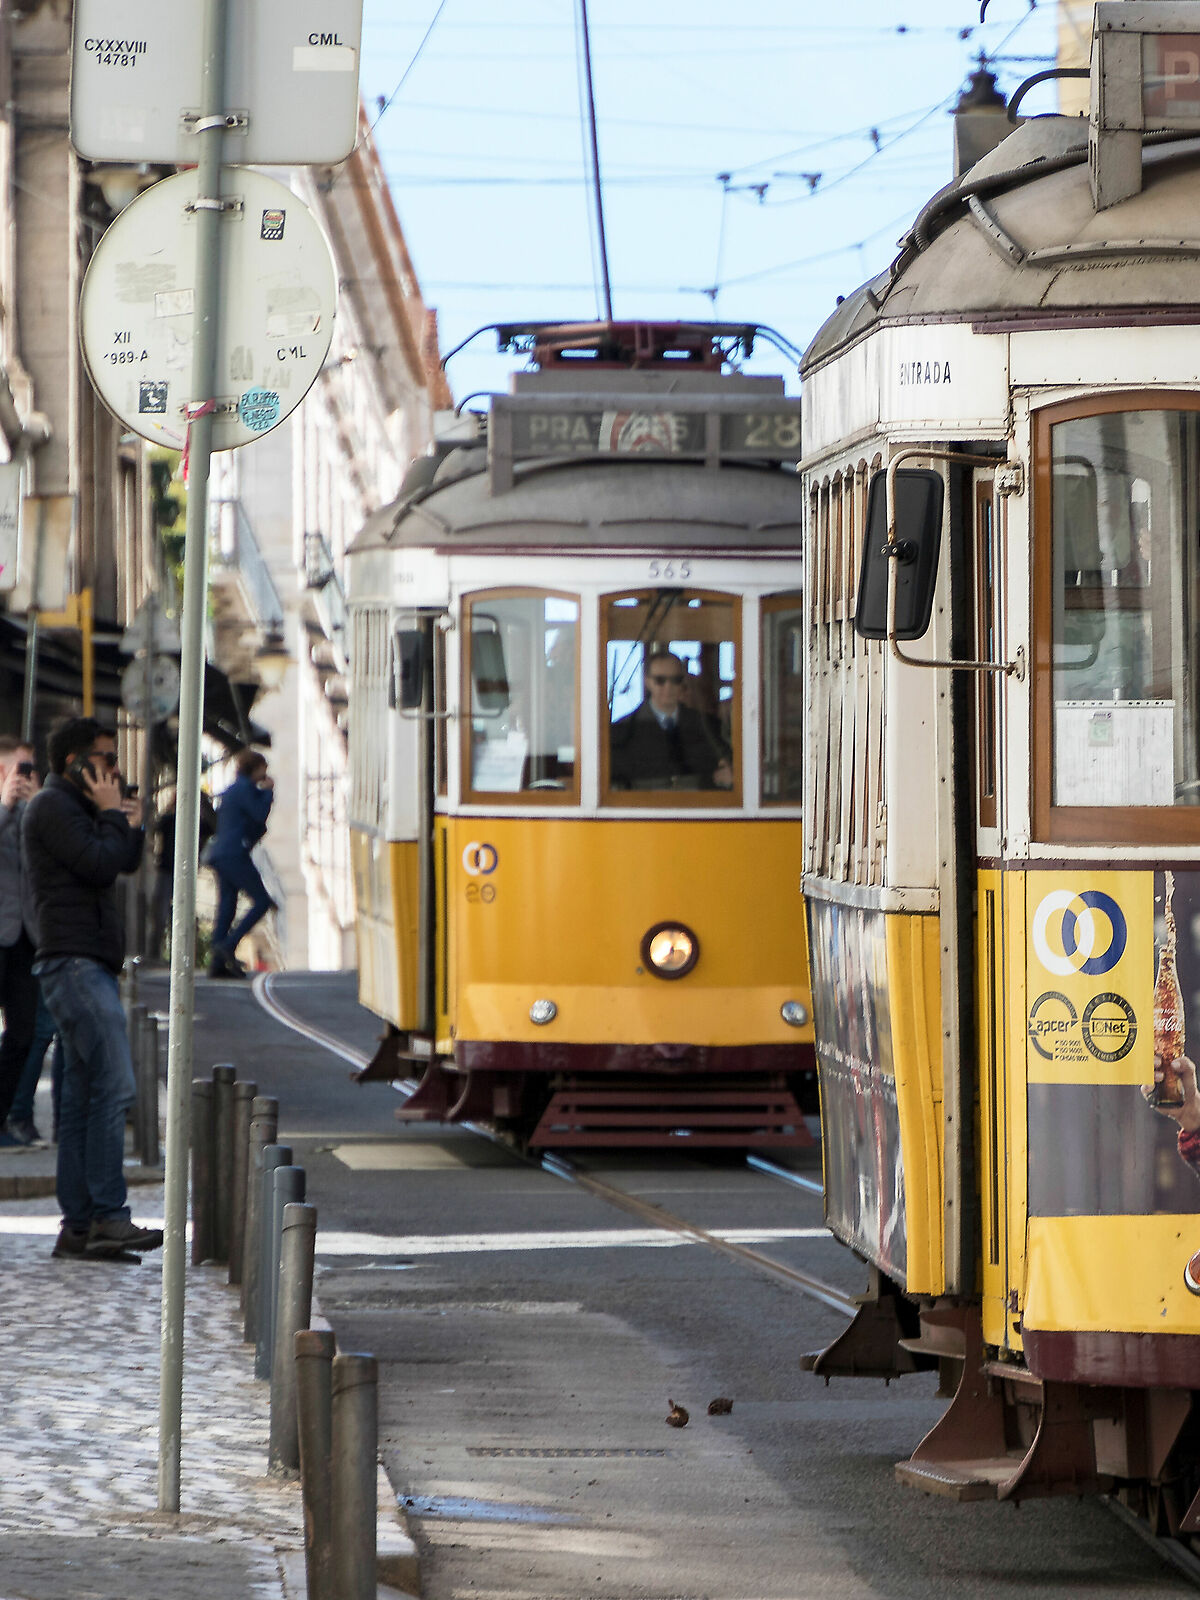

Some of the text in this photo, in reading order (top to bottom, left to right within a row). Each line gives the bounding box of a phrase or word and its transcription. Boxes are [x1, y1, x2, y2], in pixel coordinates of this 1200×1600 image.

[84, 38, 147, 53] CXXXVIII
[308, 33, 343, 46] CML
[96, 52, 136, 67] 14781
[113, 331, 131, 344] XII
[900, 361, 952, 386] ENTRADA
[744, 413, 800, 448] 28
[648, 560, 691, 579] 565
